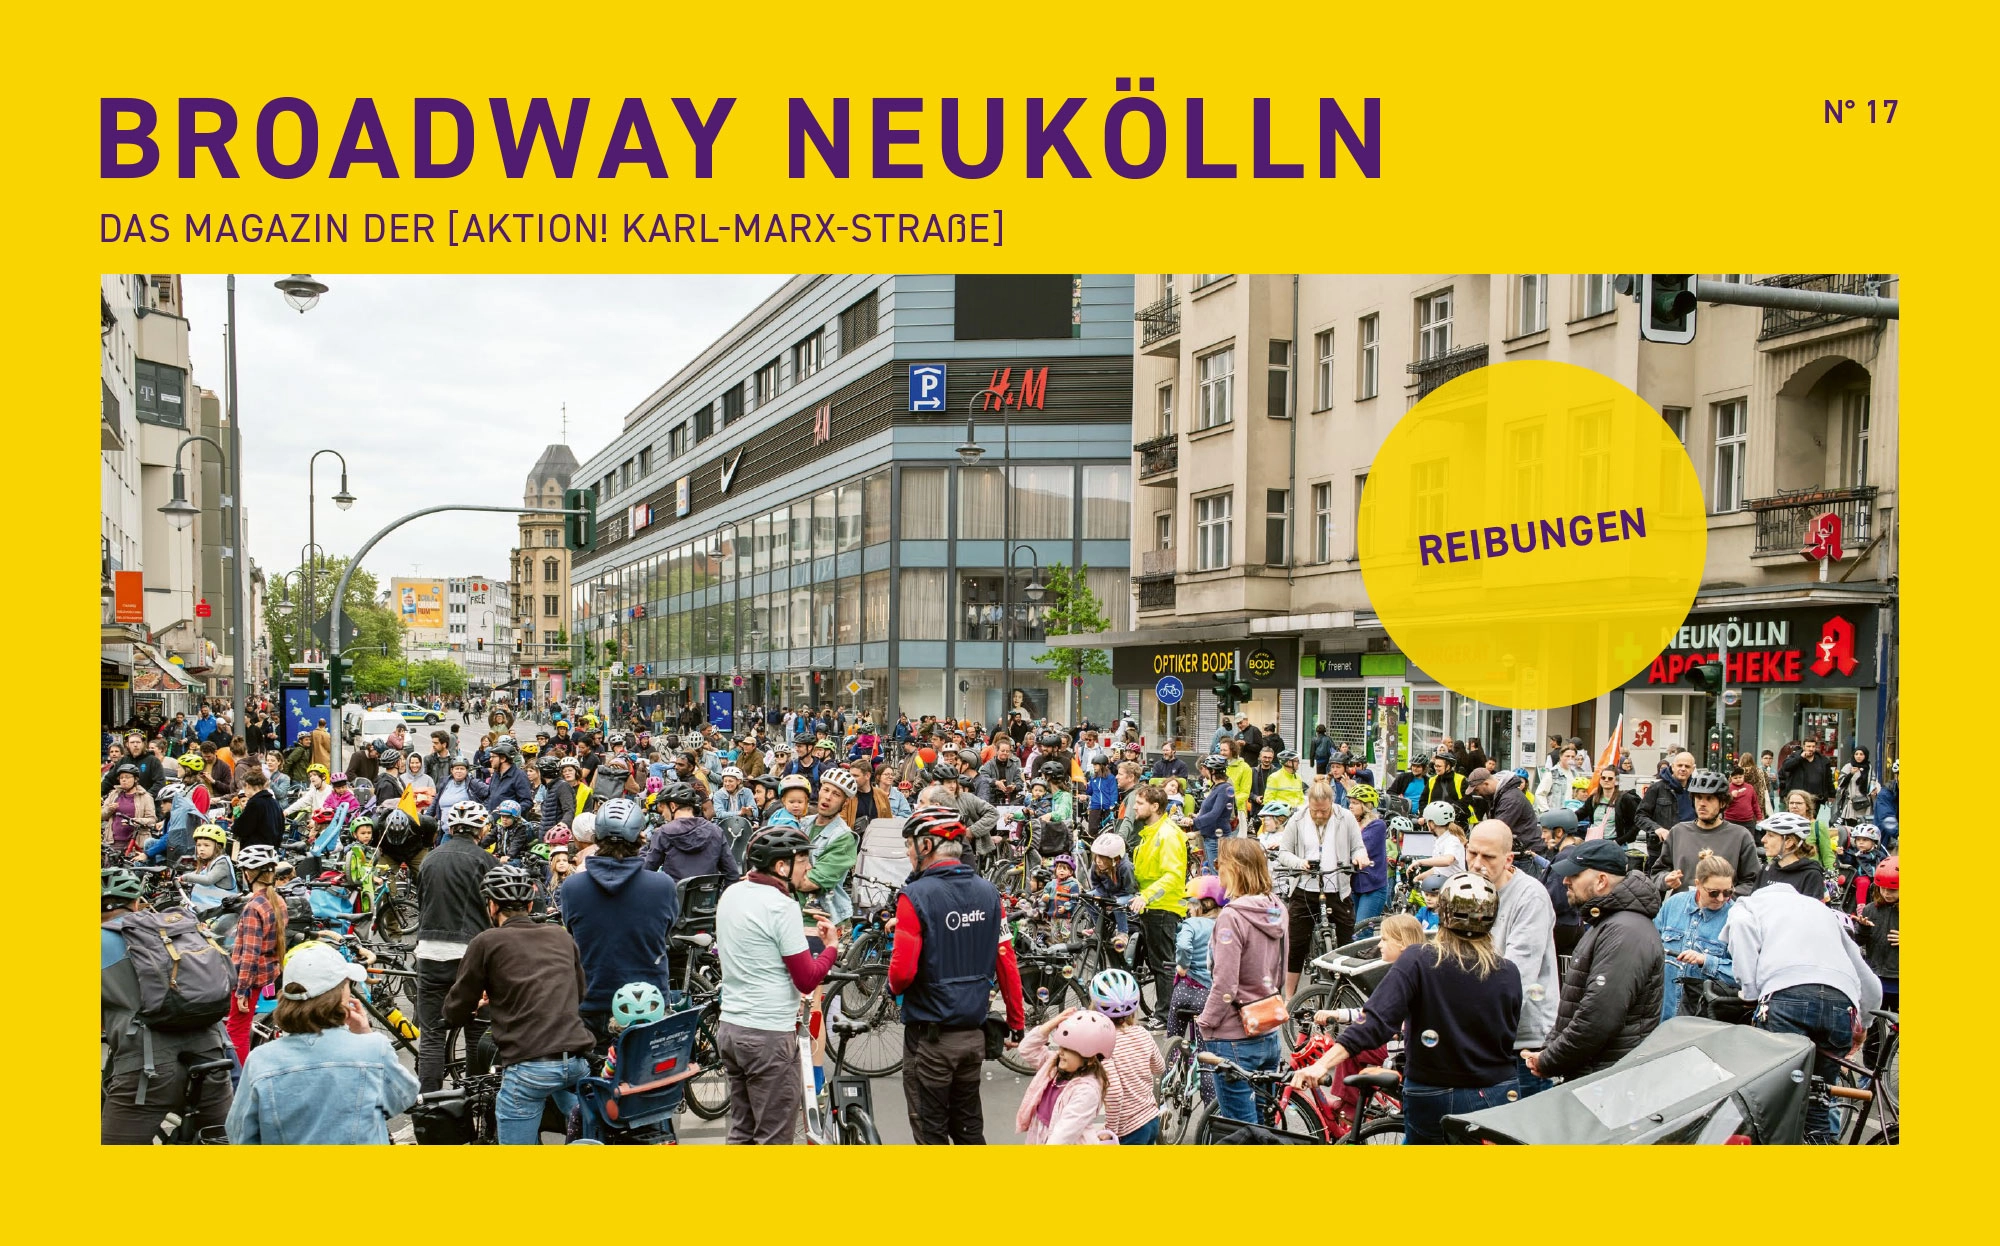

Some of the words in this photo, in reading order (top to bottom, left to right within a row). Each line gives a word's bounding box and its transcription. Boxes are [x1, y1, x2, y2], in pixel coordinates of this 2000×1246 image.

[920, 373, 938, 398] P
[983, 366, 1049, 411] H&M
[1661, 616, 1789, 650] NEUKÖLLN
[1153, 653, 1198, 674] OPTIKER
[1201, 651, 1234, 673] BODE
[1249, 659, 1276, 670] BODE
[1328, 660, 1352, 671] freenet
[961, 909, 986, 923] adfc
